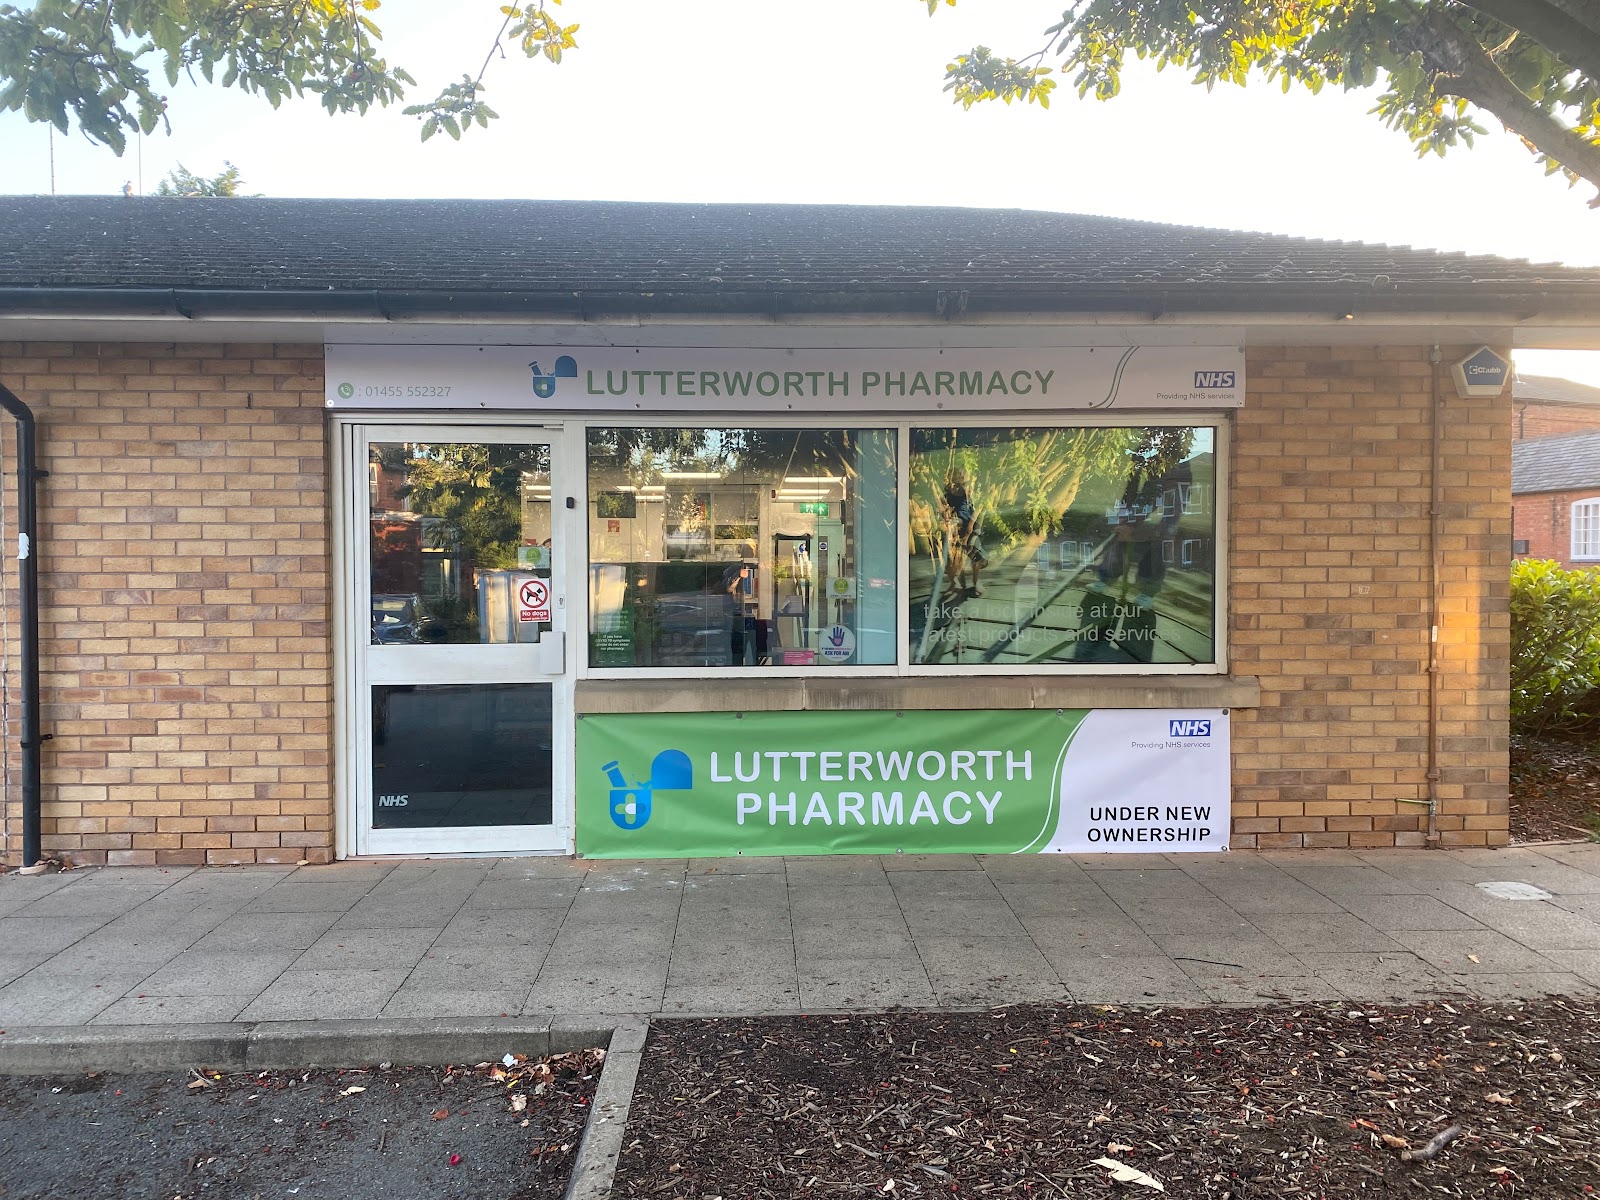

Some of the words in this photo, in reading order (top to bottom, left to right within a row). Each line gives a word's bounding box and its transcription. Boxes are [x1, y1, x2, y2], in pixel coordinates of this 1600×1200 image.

[1478, 366, 1501, 374] Chubb
[587, 370, 849, 397] LUTTERWORTH
[862, 370, 1054, 397] PHARMACY
[1195, 372, 1234, 387] NHS
[365, 386, 403, 397] 01455
[407, 386, 452, 397] 552327
[924, 603, 961, 619] take
[1090, 604, 1107, 619] at
[1112, 606, 1143, 619] our
[980, 625, 1057, 646] products
[1066, 625, 1098, 642] and
[1104, 625, 1181, 642] services
[1170, 720, 1209, 736] NHS
[1131, 741, 1164, 749] Providing
[710, 750, 1032, 782] LUTTERWORTH
[378, 794, 409, 807] NHS
[736, 791, 1002, 826] PHARMACY
[1090, 806, 1159, 821] UNDER
[1166, 806, 1211, 821] NEW
[1087, 827, 1211, 842] OWNERSHIP
